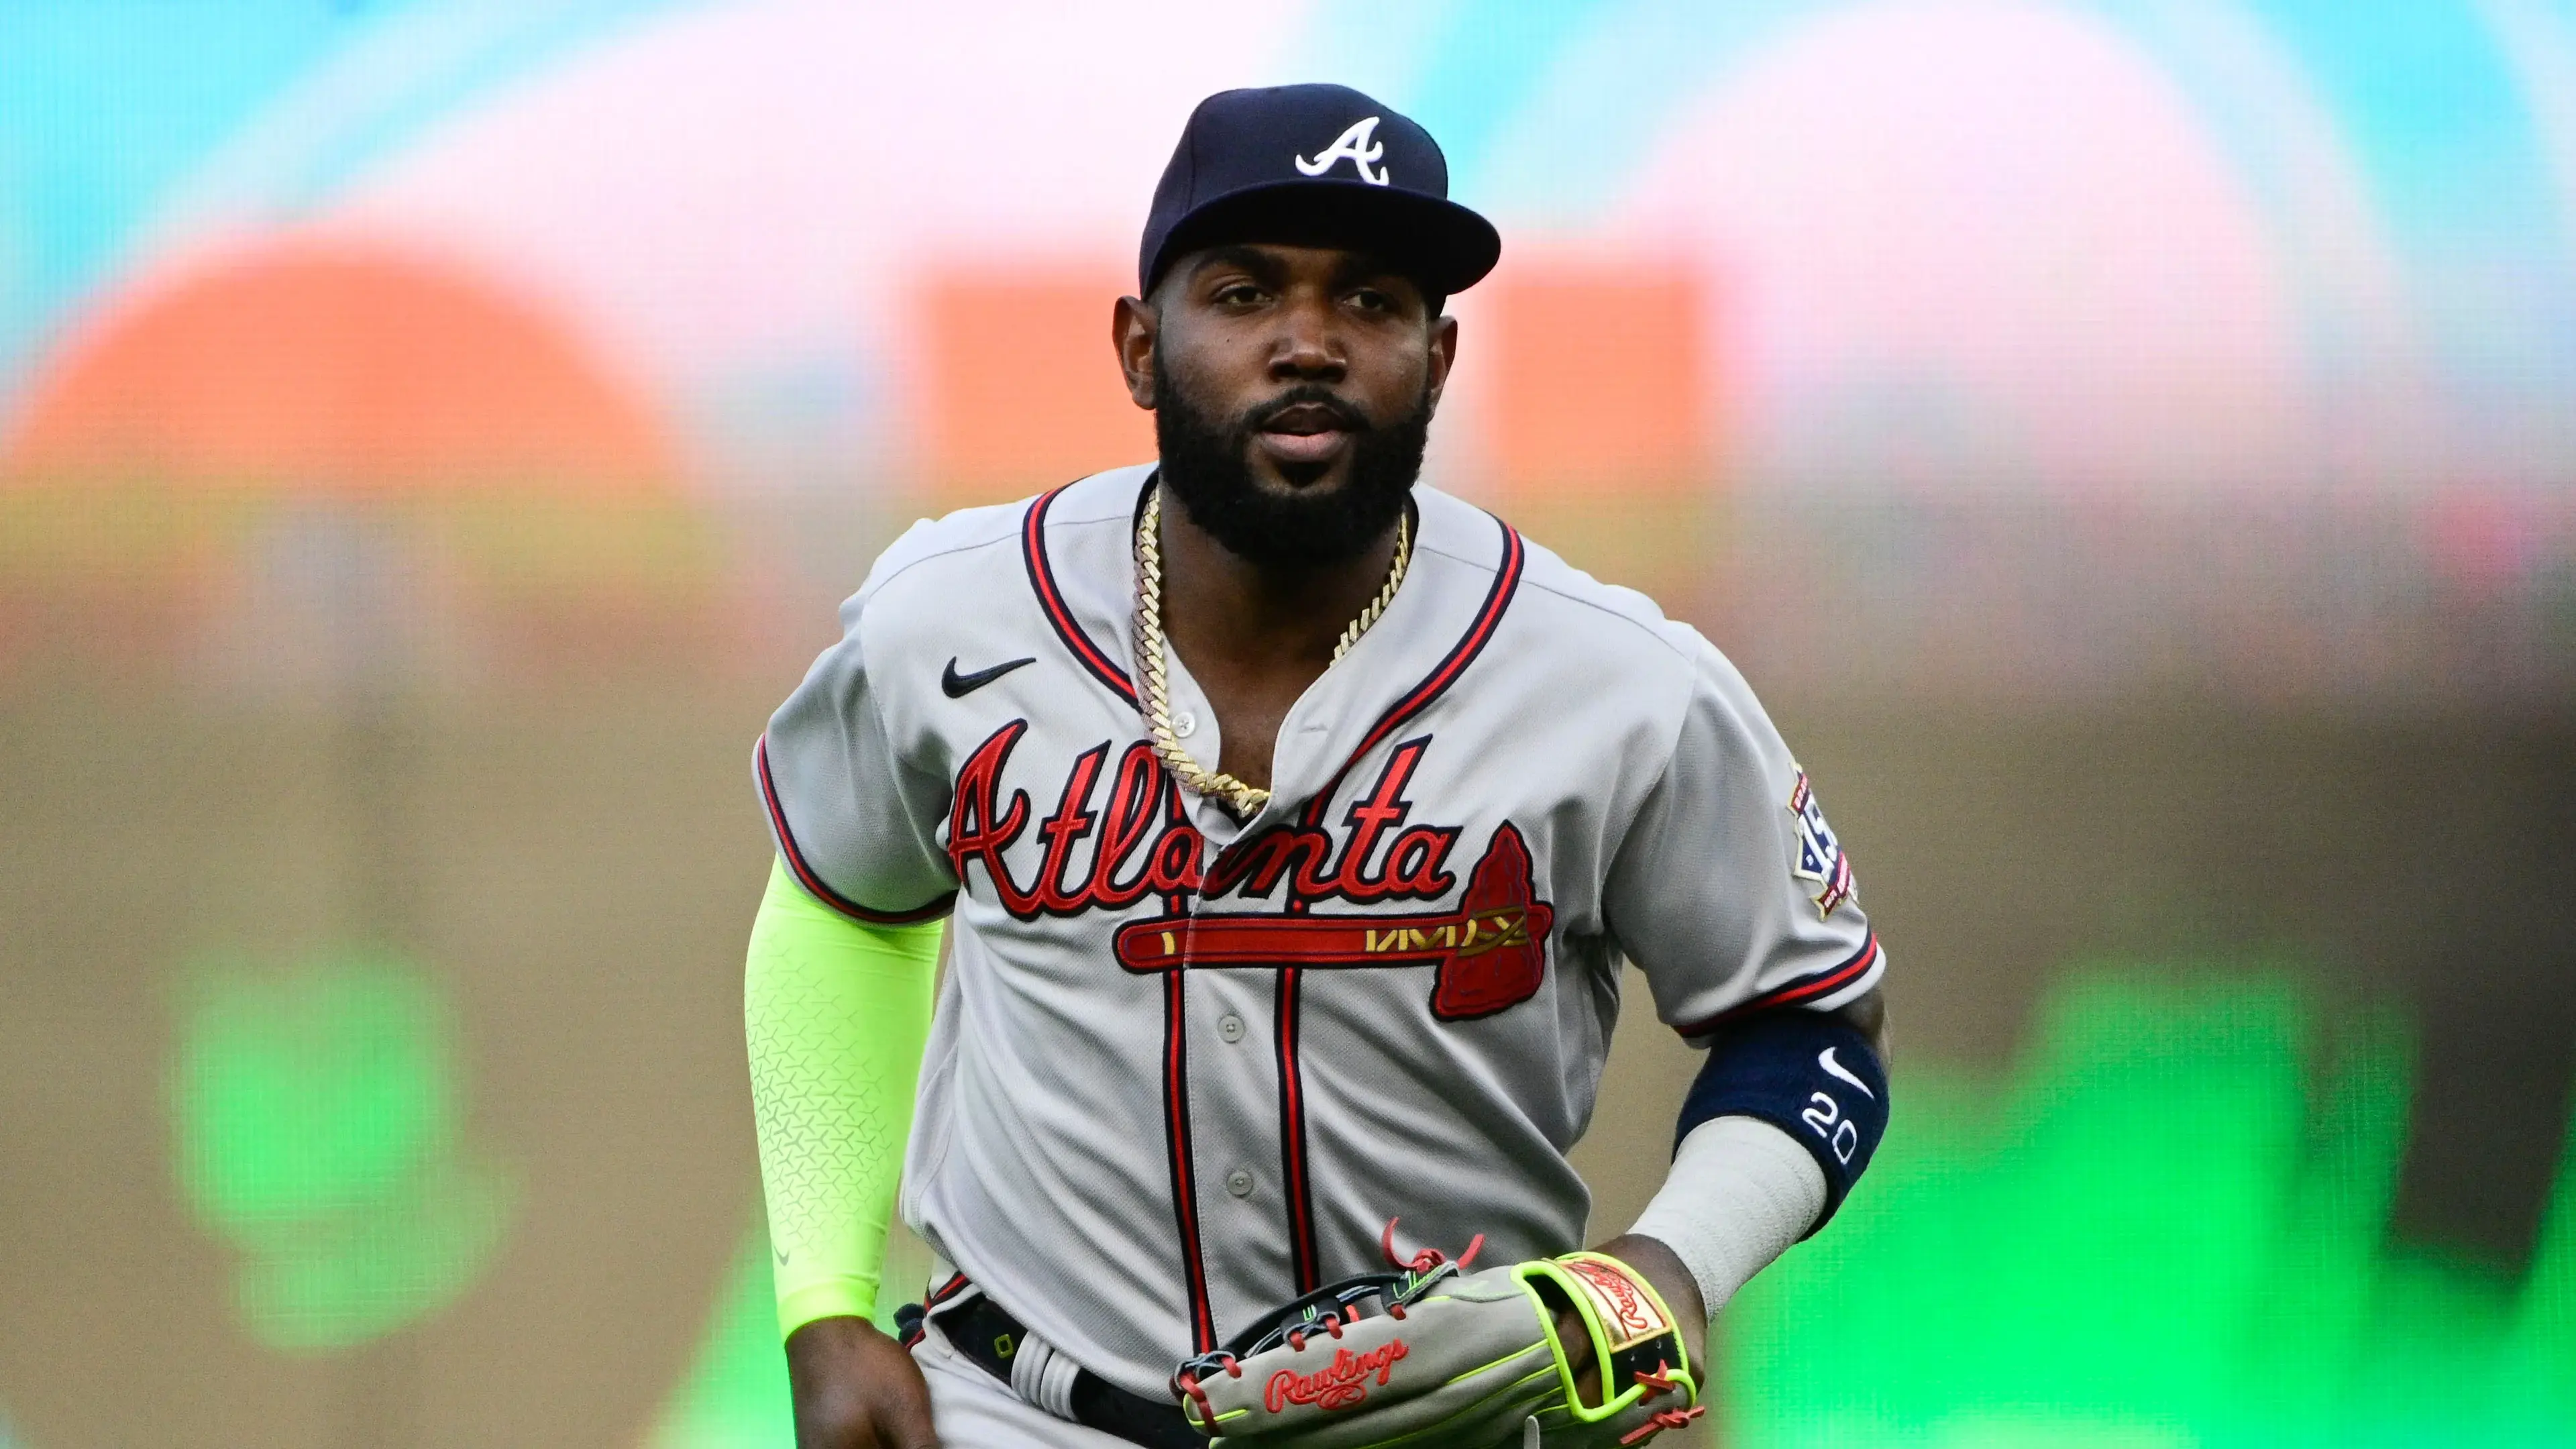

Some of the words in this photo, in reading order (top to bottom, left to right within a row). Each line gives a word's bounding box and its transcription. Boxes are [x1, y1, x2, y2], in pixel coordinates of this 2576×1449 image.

[1295, 115, 1389, 186] A
[947, 718, 1464, 921] Atlanta
[1801, 1091, 1858, 1165] 20
[1264, 1338, 1409, 1414] Rawlings
